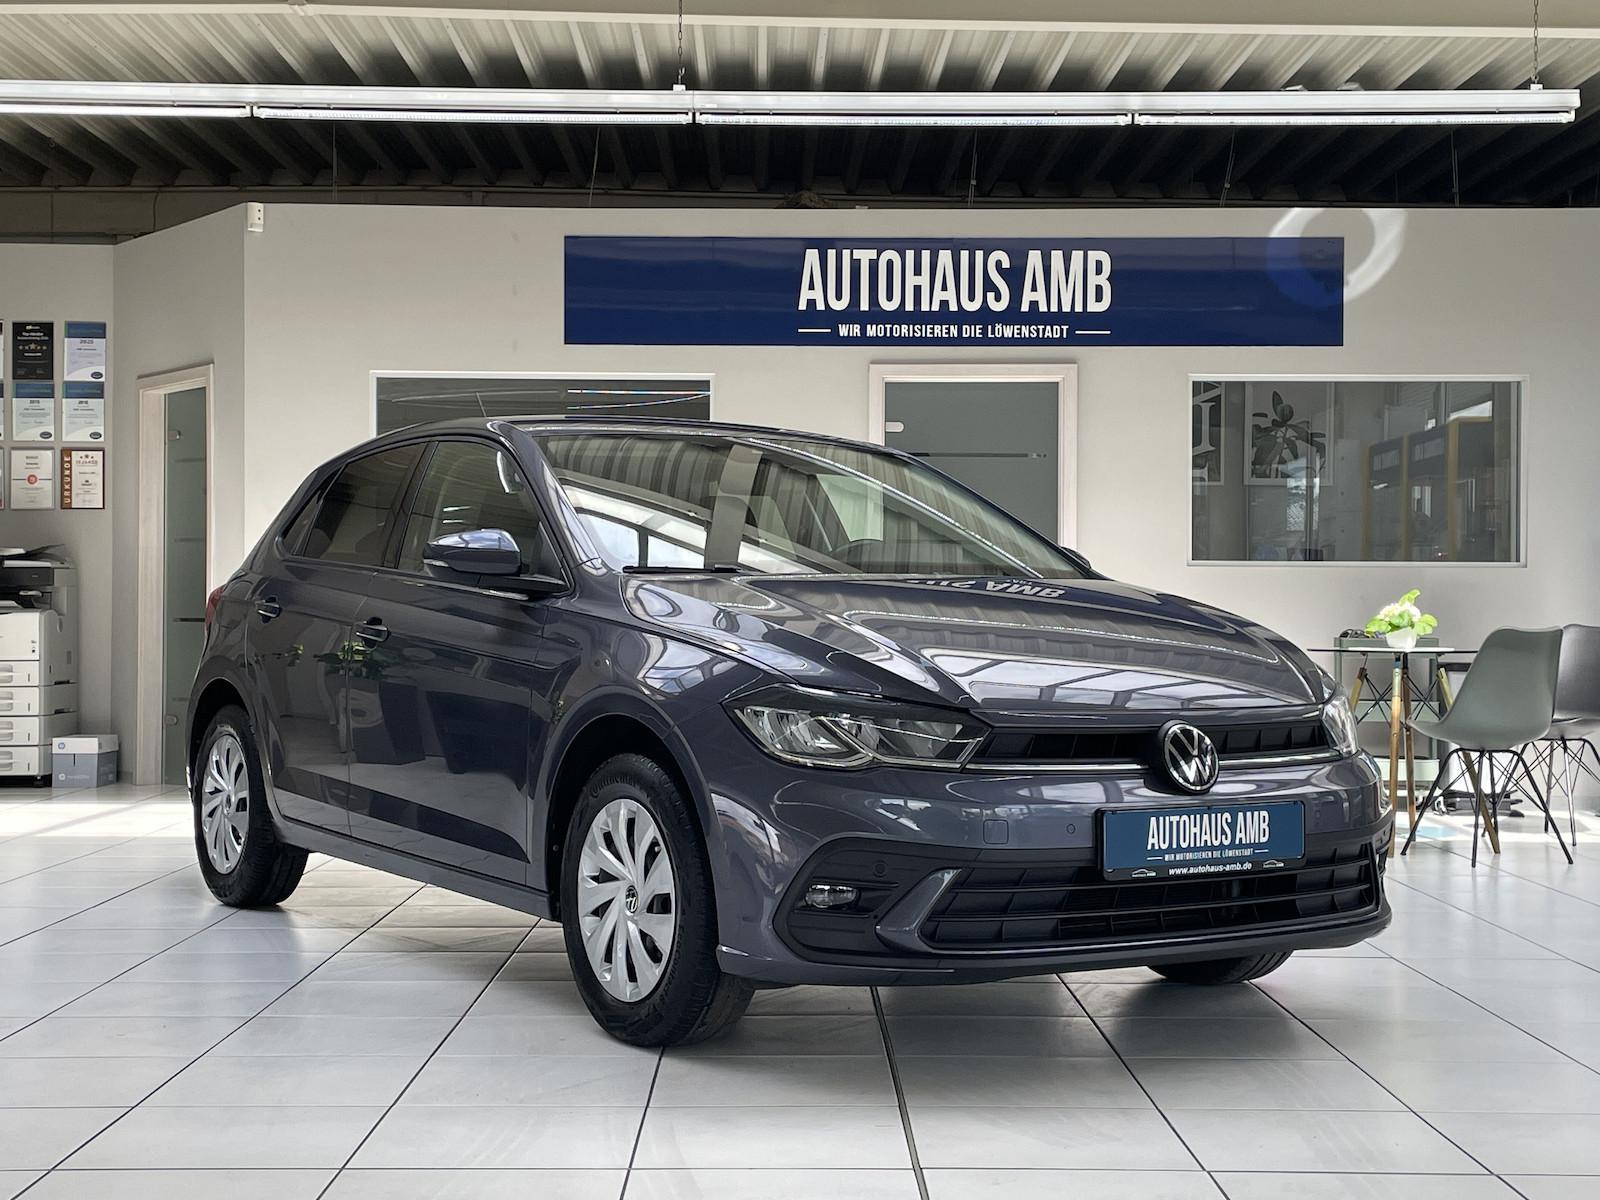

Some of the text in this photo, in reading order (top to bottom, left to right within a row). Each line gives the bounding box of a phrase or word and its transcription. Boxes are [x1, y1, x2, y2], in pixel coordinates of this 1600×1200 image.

[798, 248, 1112, 313] AUTOHAUS AMB
[838, 323, 1069, 339] WIR MOTORISIEREN DIE LÖWENSTADT
[1147, 810, 1270, 850] AUTOHAUS AMB
[1168, 861, 1253, 876] www.autohaus-amb.de
